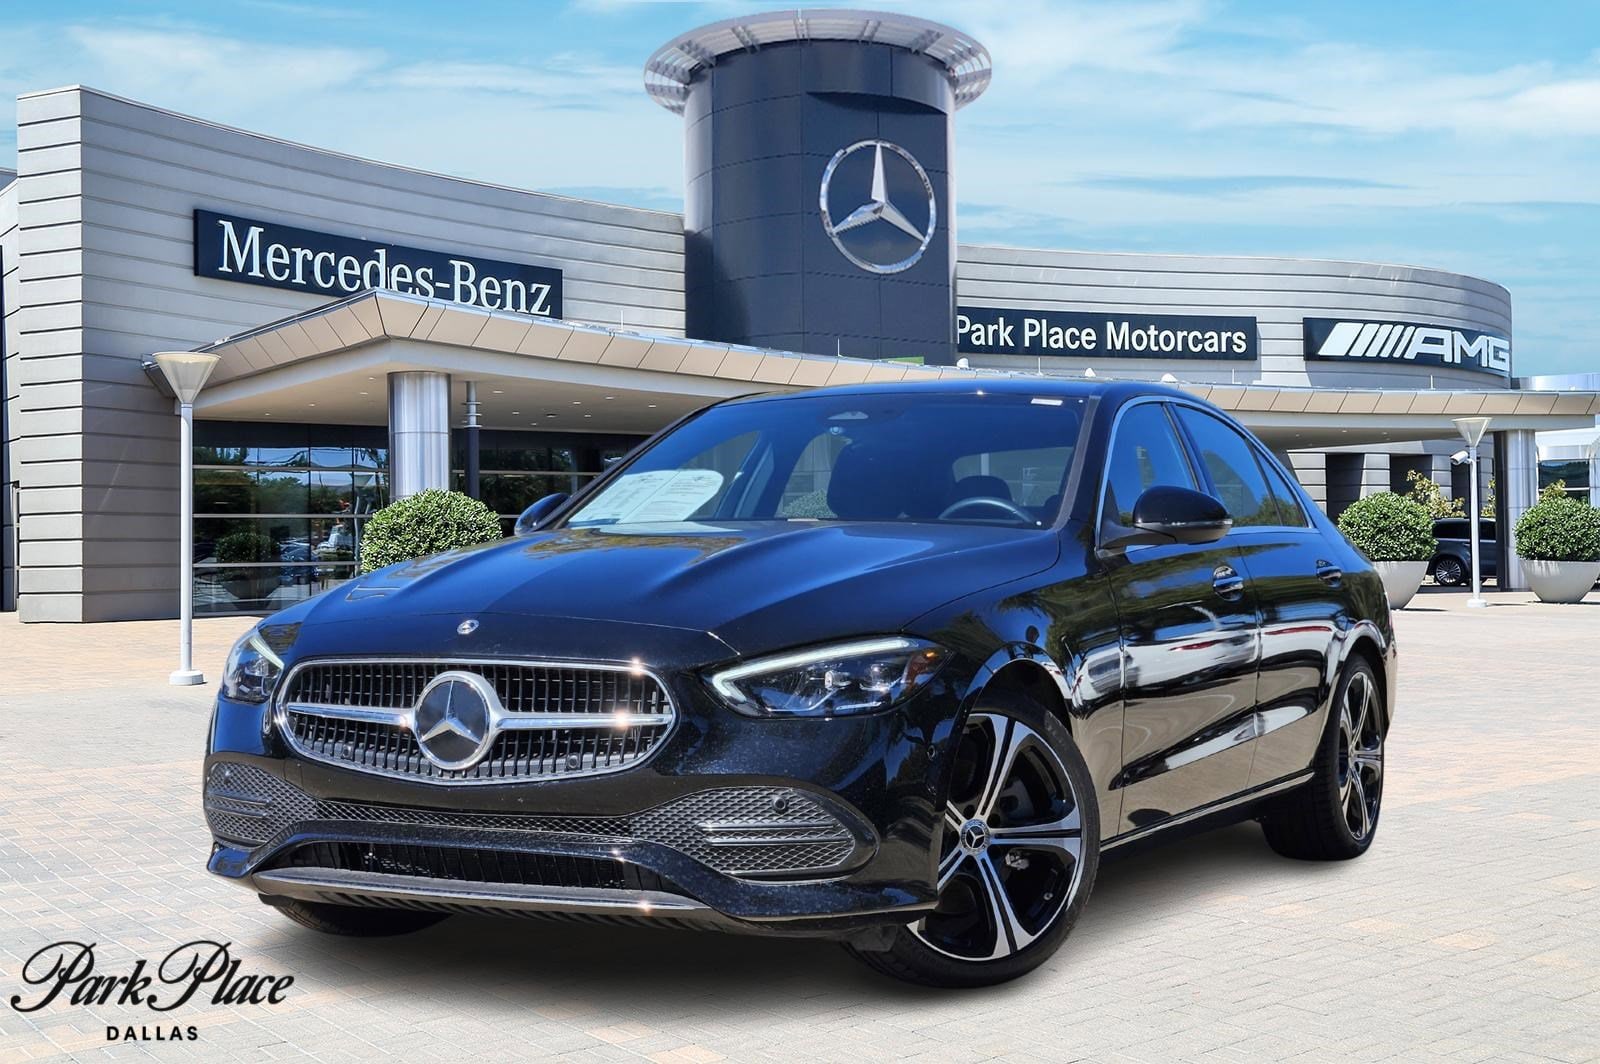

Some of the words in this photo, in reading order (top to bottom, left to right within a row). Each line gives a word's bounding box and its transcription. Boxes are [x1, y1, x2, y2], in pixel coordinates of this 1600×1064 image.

[217, 219, 552, 317] Mercedes-Benz
[956, 315, 1015, 347] Park
[1023, 318, 1097, 350] Place
[1106, 321, 1248, 354] Motorcars
